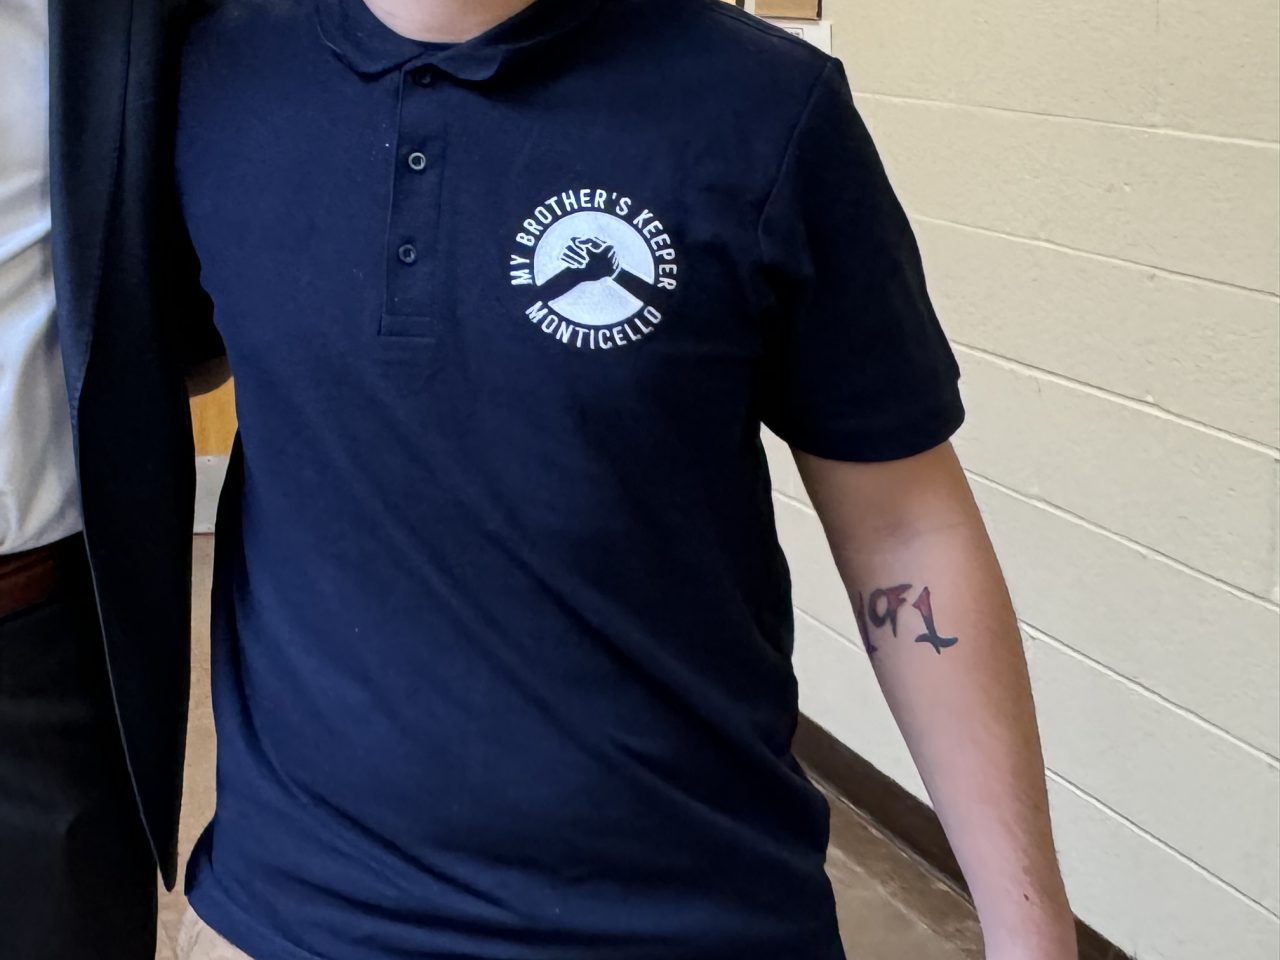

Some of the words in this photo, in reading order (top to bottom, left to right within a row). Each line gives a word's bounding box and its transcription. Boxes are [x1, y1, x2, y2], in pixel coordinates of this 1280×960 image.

[515, 189, 632, 247] BROTHER'S
[509, 254, 533, 286] MY
[632, 209, 678, 290] KEEPER
[525, 300, 662, 350] MONTICELLO
